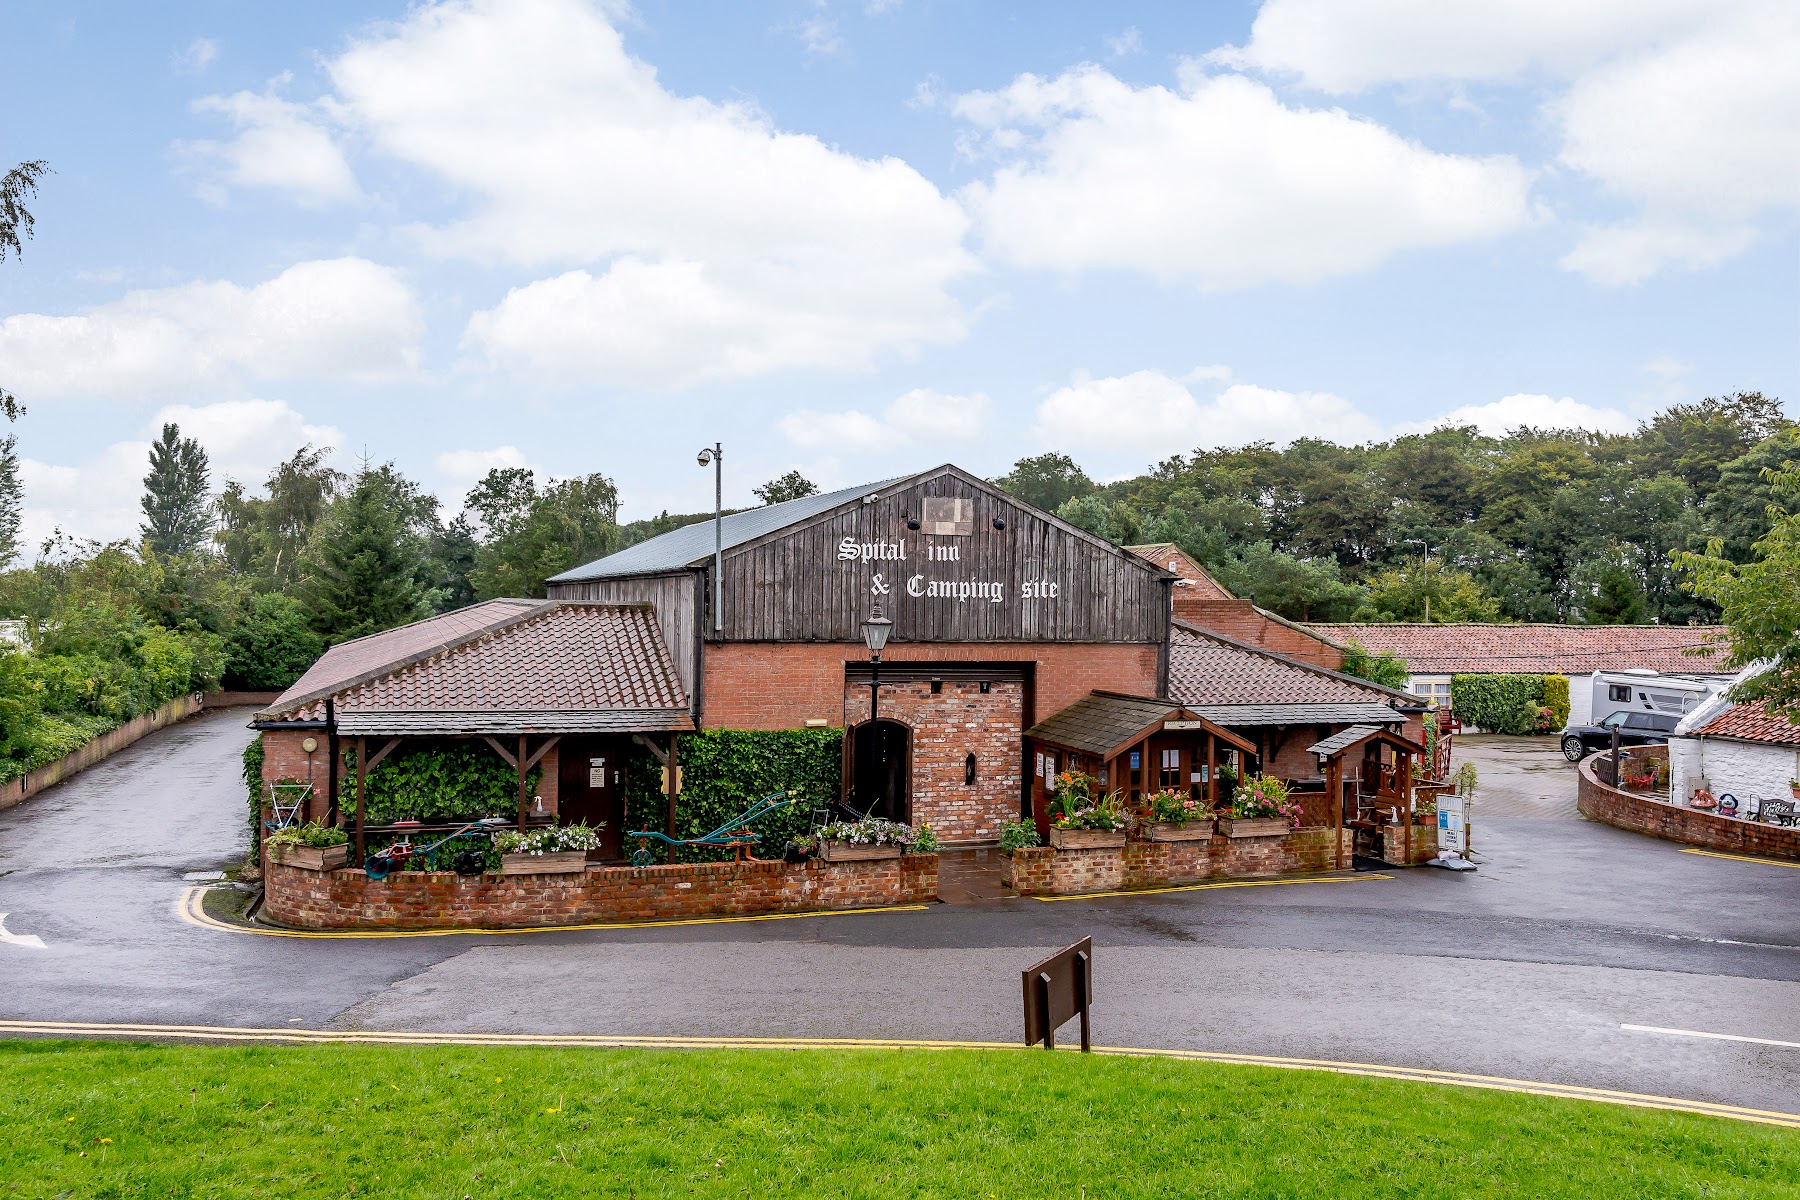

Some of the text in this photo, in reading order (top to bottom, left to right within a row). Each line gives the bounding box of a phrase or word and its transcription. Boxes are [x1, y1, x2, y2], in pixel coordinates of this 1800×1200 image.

[837, 536, 961, 564] Spital inn
[870, 573, 1058, 603] & Camping site
